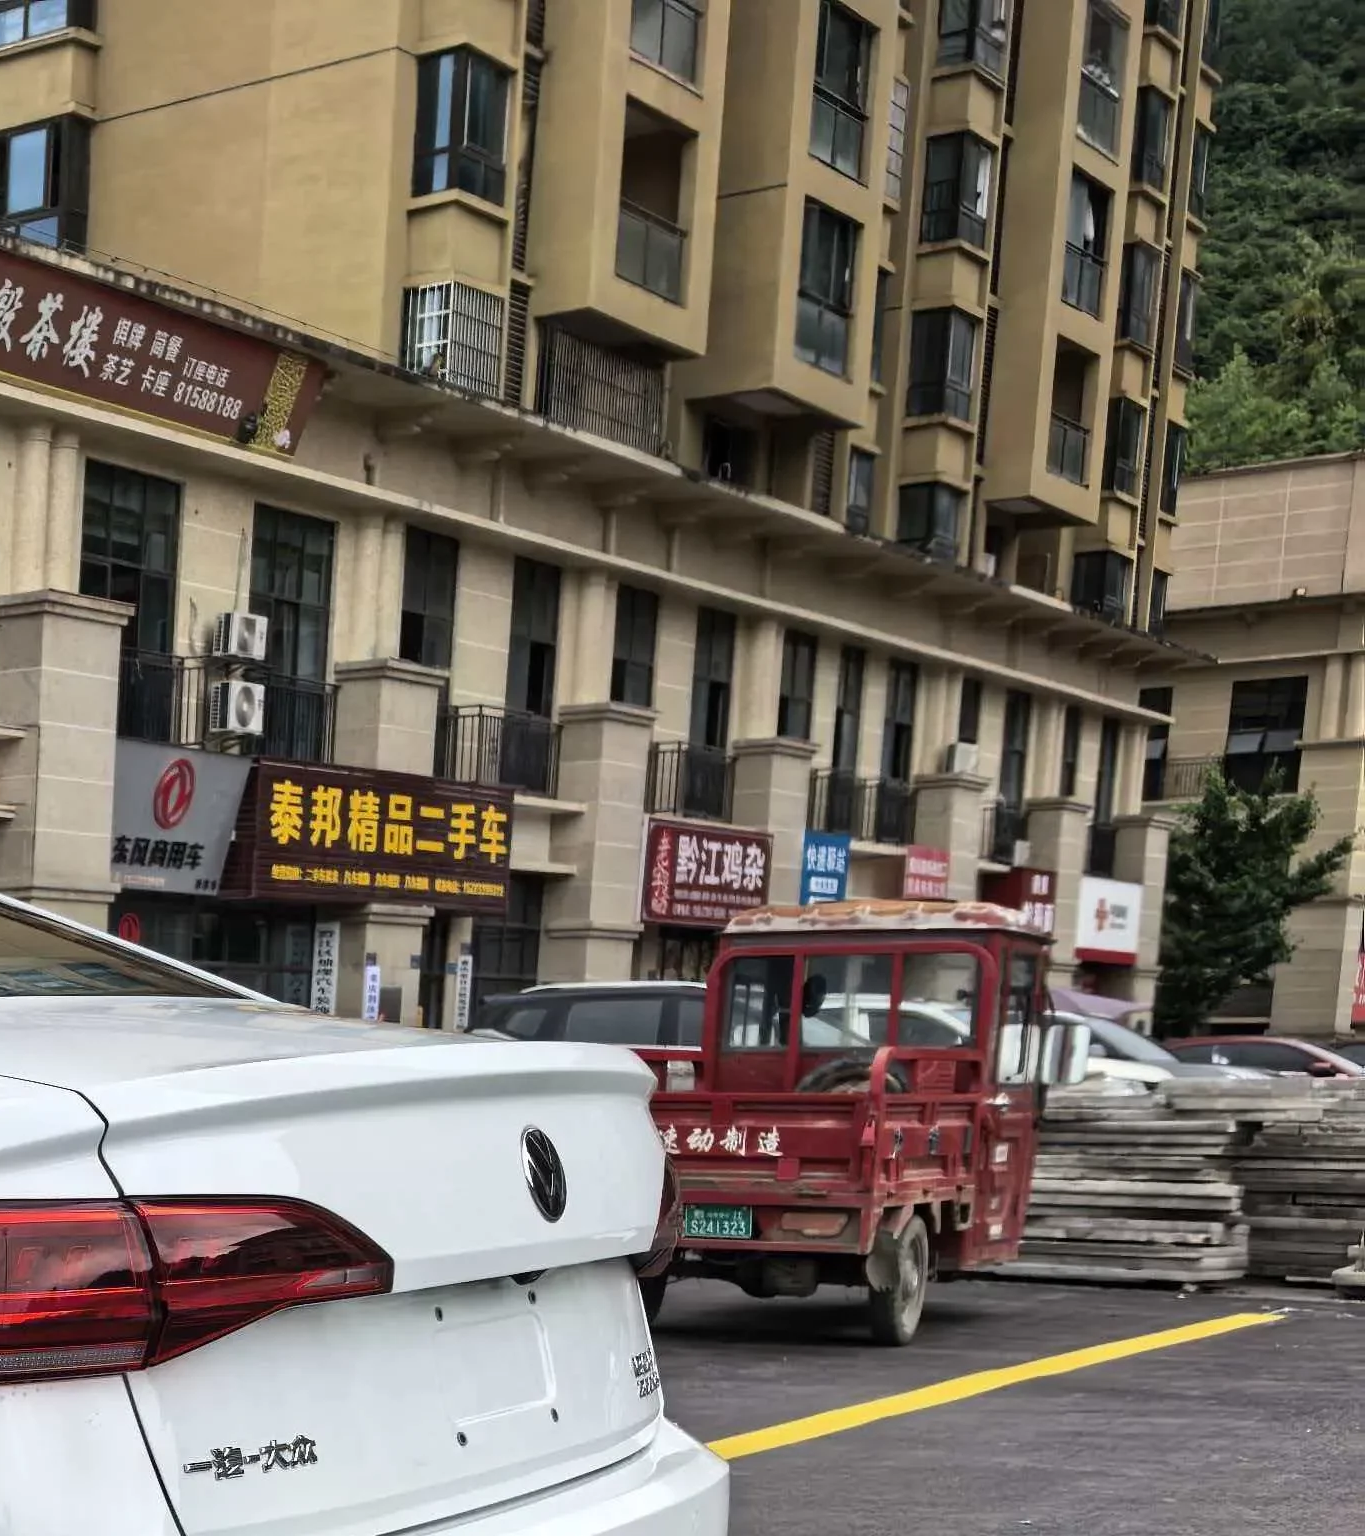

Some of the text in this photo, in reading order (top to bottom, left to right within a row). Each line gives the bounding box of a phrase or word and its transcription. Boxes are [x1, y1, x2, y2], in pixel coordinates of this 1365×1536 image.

[173, 381, 243, 420] 81588188
[112, 835, 205, 870] 东风商用车
[675, 835, 766, 891] 黔江鸡杂
